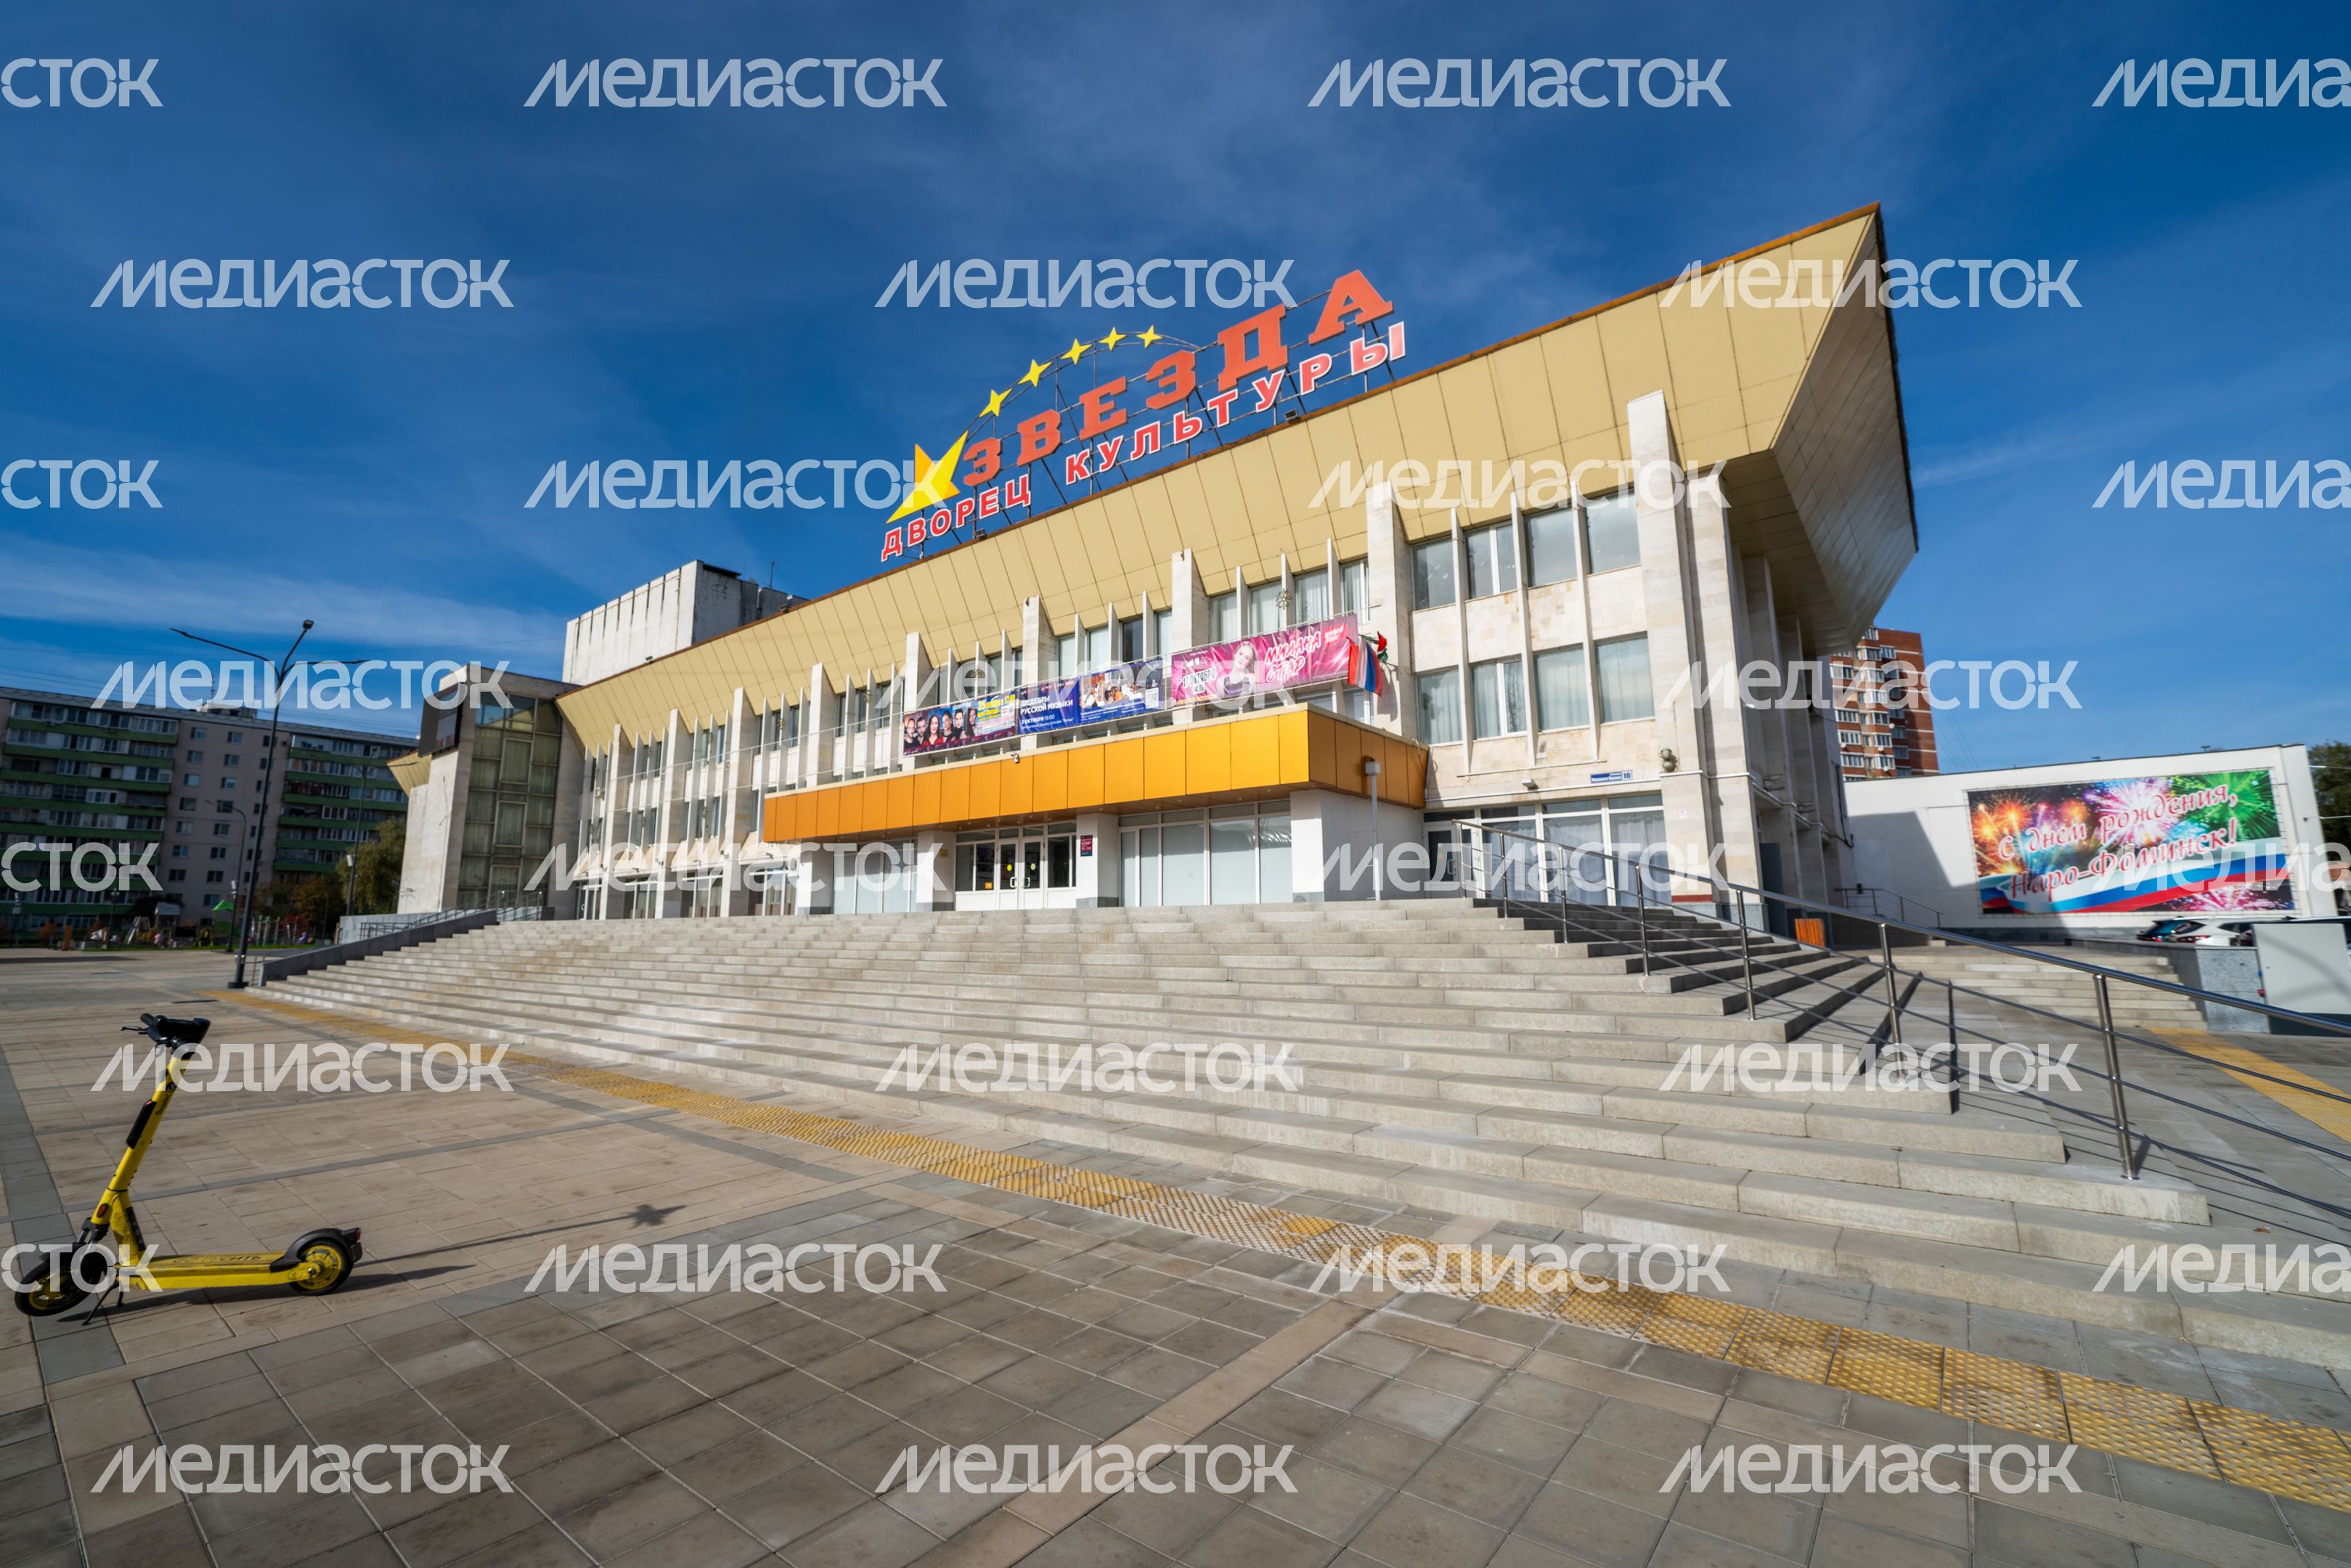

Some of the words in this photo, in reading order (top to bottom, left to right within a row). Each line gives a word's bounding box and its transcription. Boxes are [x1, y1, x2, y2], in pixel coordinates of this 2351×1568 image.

[963, 269, 1393, 486] ЗВЕЗДА
[881, 474, 1031, 562] ДВОРЕЦ
[1066, 321, 1406, 485] КУЛЬТУРЫ
[1264, 631, 1321, 665] МИЛАНА
[1020, 703, 1047, 714] РУССКОЙ
[1048, 700, 1073, 710] МУЗЫКИ
[1021, 695, 1050, 706] ШЕДЕВРЫ
[2026, 820, 2087, 852] днем
[2098, 783, 2238, 841] рождения,
[2010, 817, 2238, 902] Наро-Фоминск!
